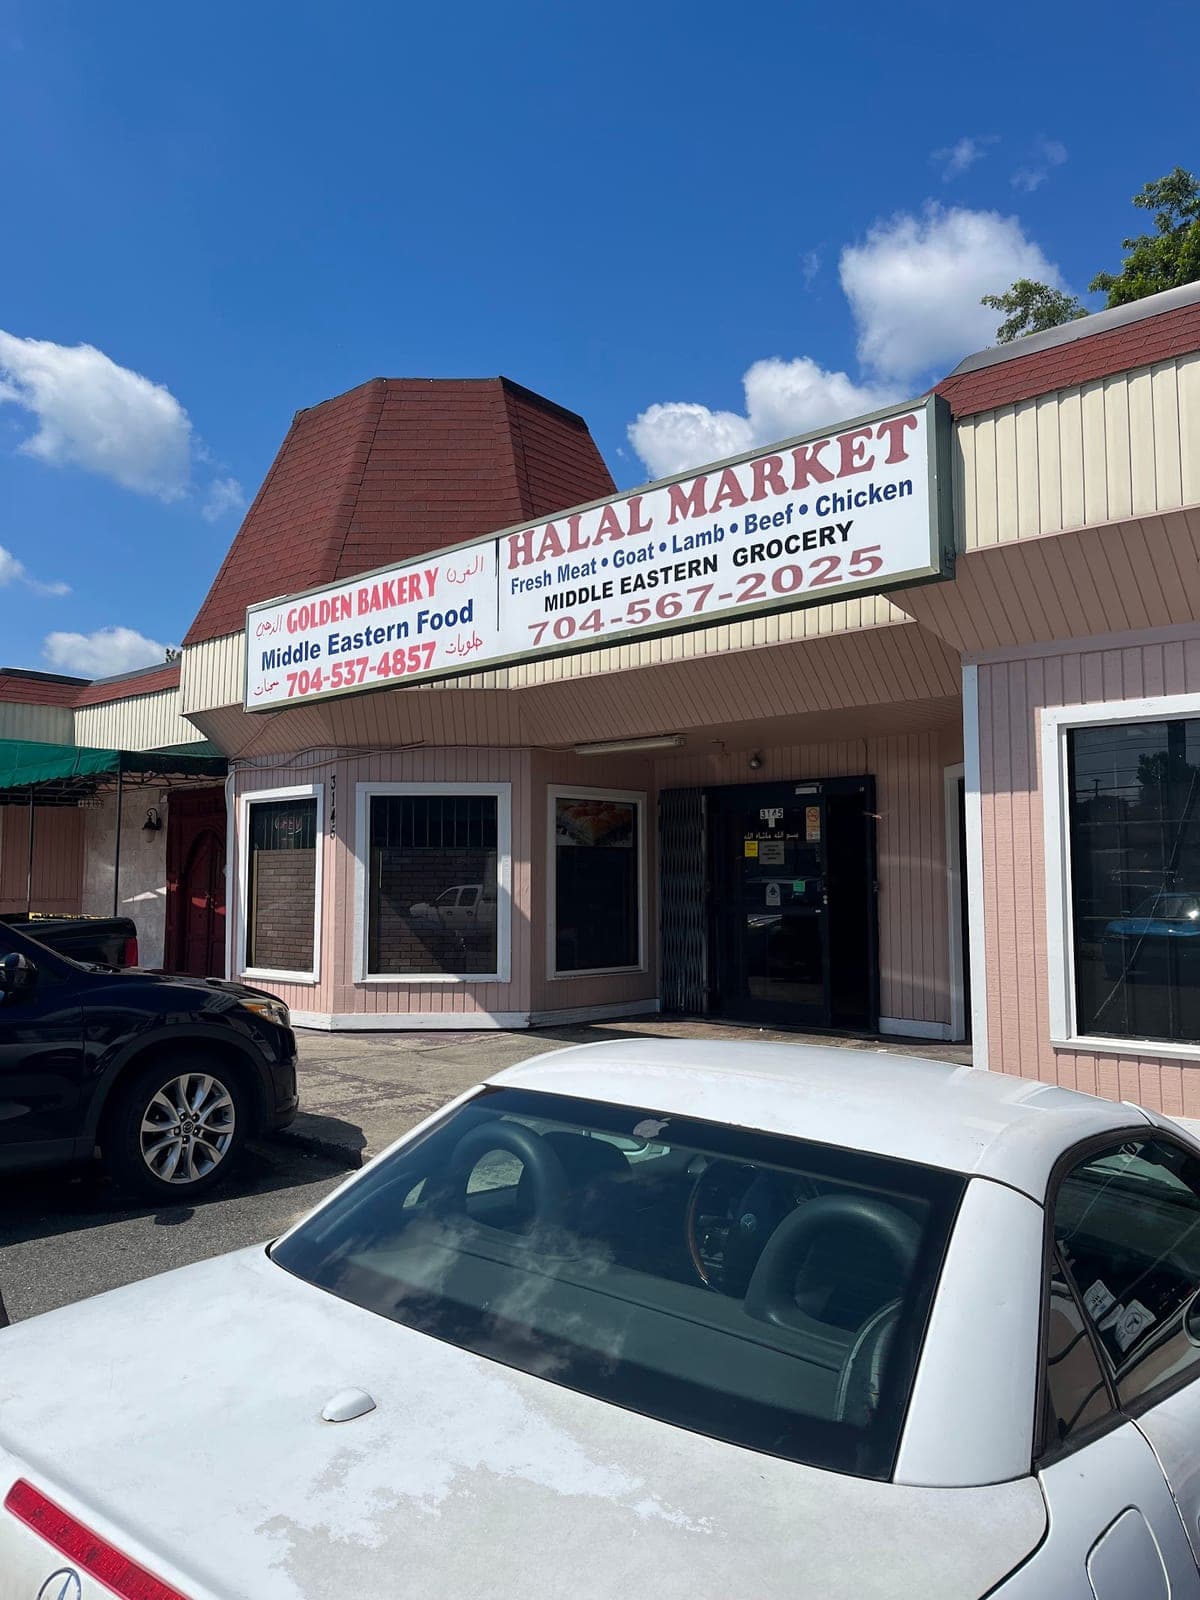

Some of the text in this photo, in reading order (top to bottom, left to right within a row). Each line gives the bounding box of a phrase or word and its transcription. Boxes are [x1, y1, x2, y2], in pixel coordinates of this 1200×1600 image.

[508, 414, 918, 570] HALAL MARKET
[446, 555, 484, 584] الفرن
[511, 479, 913, 595] Fresh Meat Goat Lamb Beef Chicken
[544, 520, 854, 613] MIDDLE EASTERN GROCERY
[261, 599, 474, 671] Middle Eastern Food
[287, 567, 439, 634] GOLDEN BAKERY
[528, 544, 884, 646] 704-567-2025
[286, 641, 436, 698] 704-537-4857
